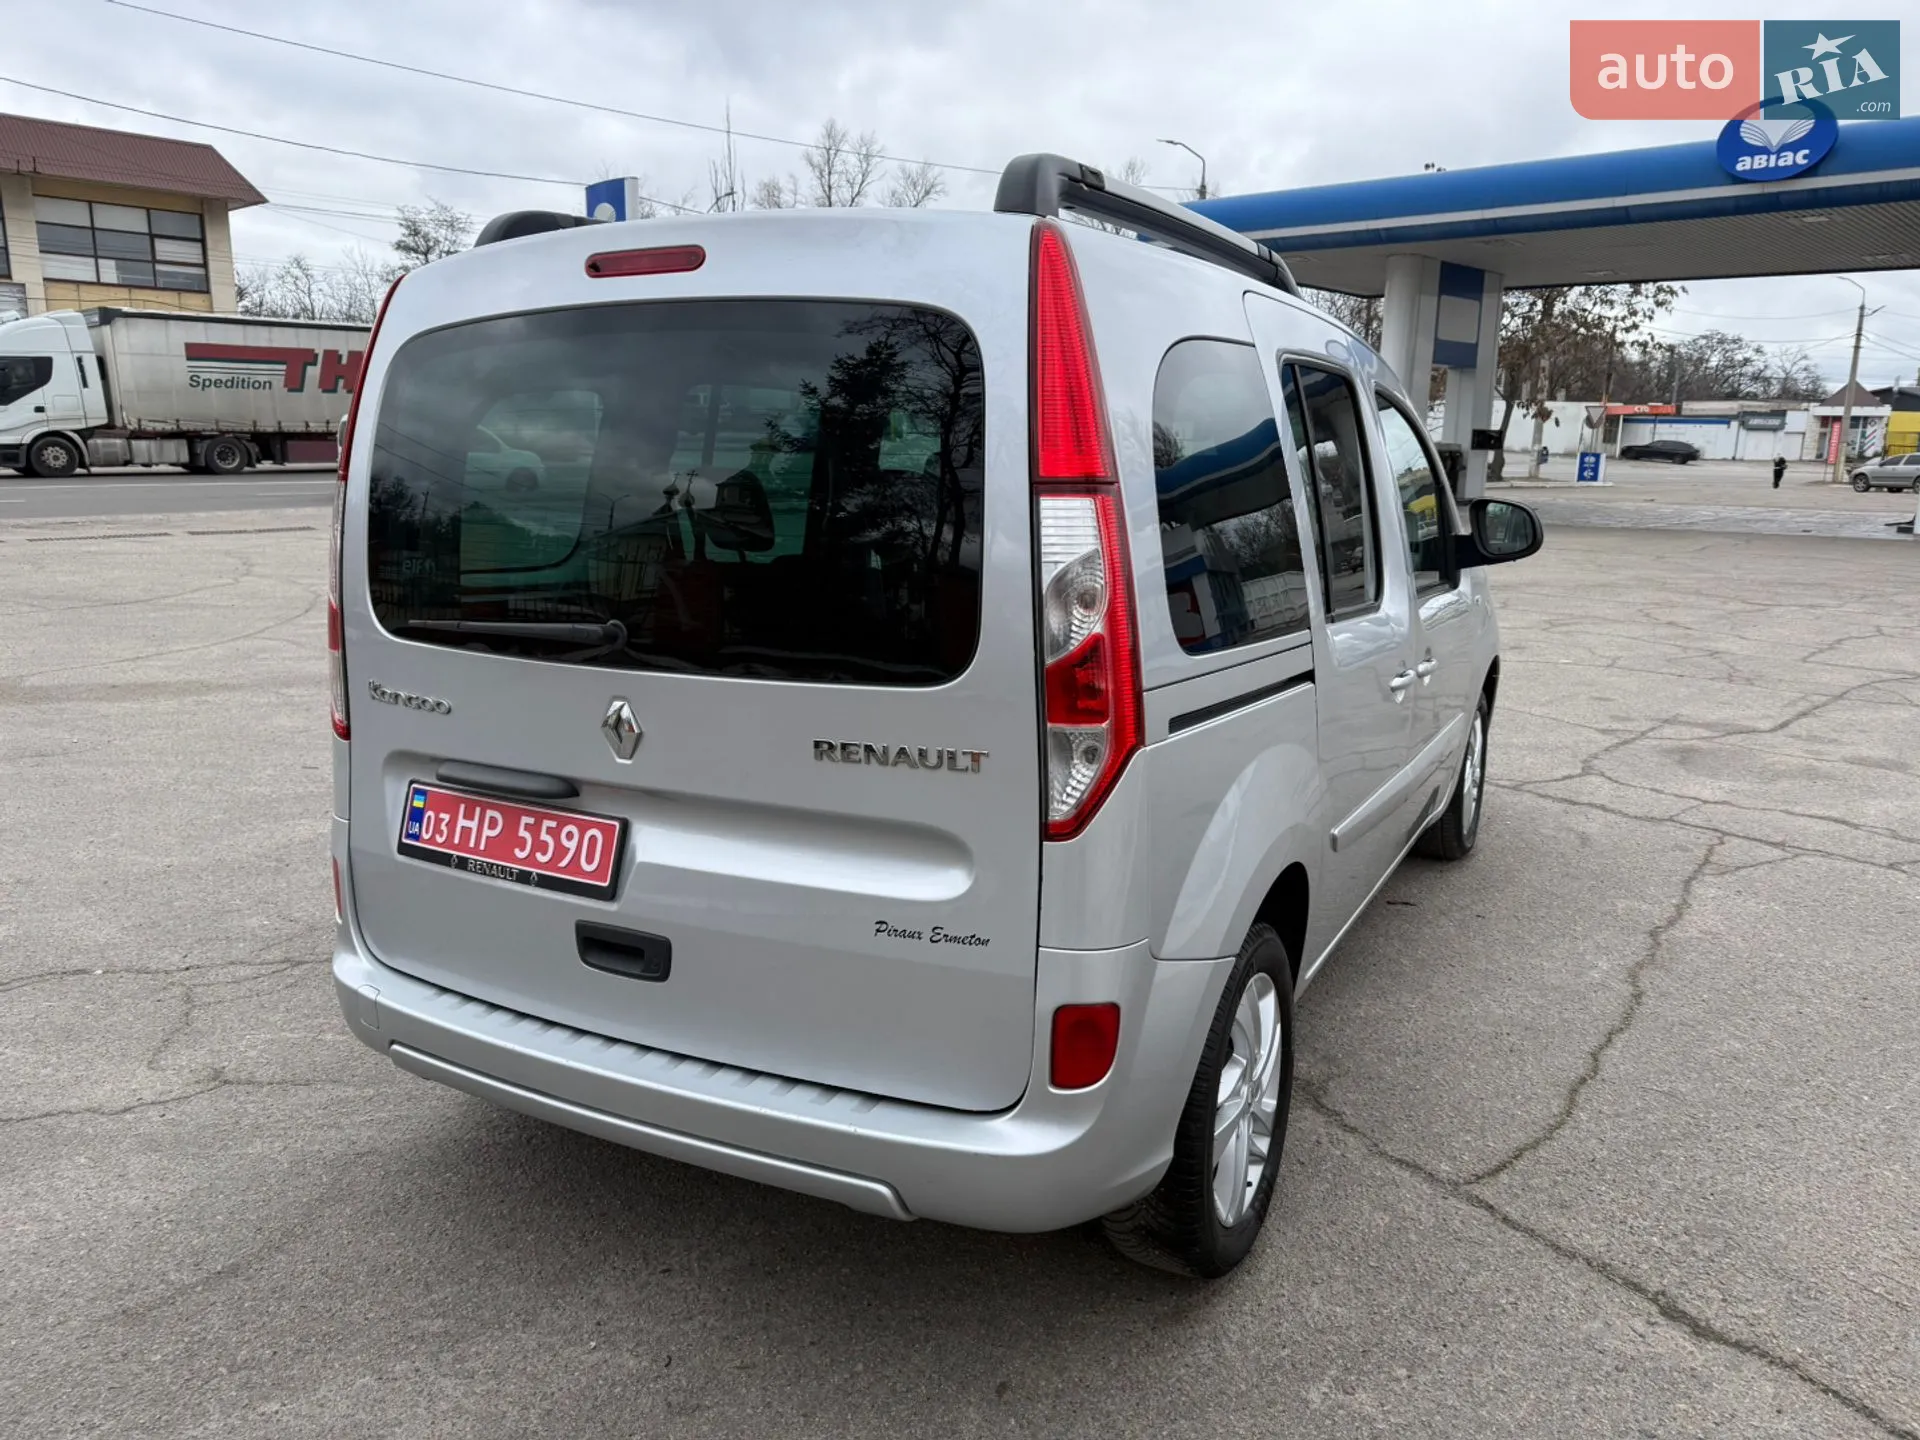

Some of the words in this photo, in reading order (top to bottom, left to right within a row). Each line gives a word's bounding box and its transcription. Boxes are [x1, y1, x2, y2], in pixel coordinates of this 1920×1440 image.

[188, 374, 273, 391] Spedition
[812, 738, 990, 774] RENAULT
[408, 820, 420, 836] UA
[421, 810, 451, 843] 03
[453, 803, 504, 851] HP
[513, 815, 603, 873] 5590
[466, 857, 520, 881] RENAULT
[873, 920, 924, 941] Piraux
[929, 926, 991, 948] Ermeton
